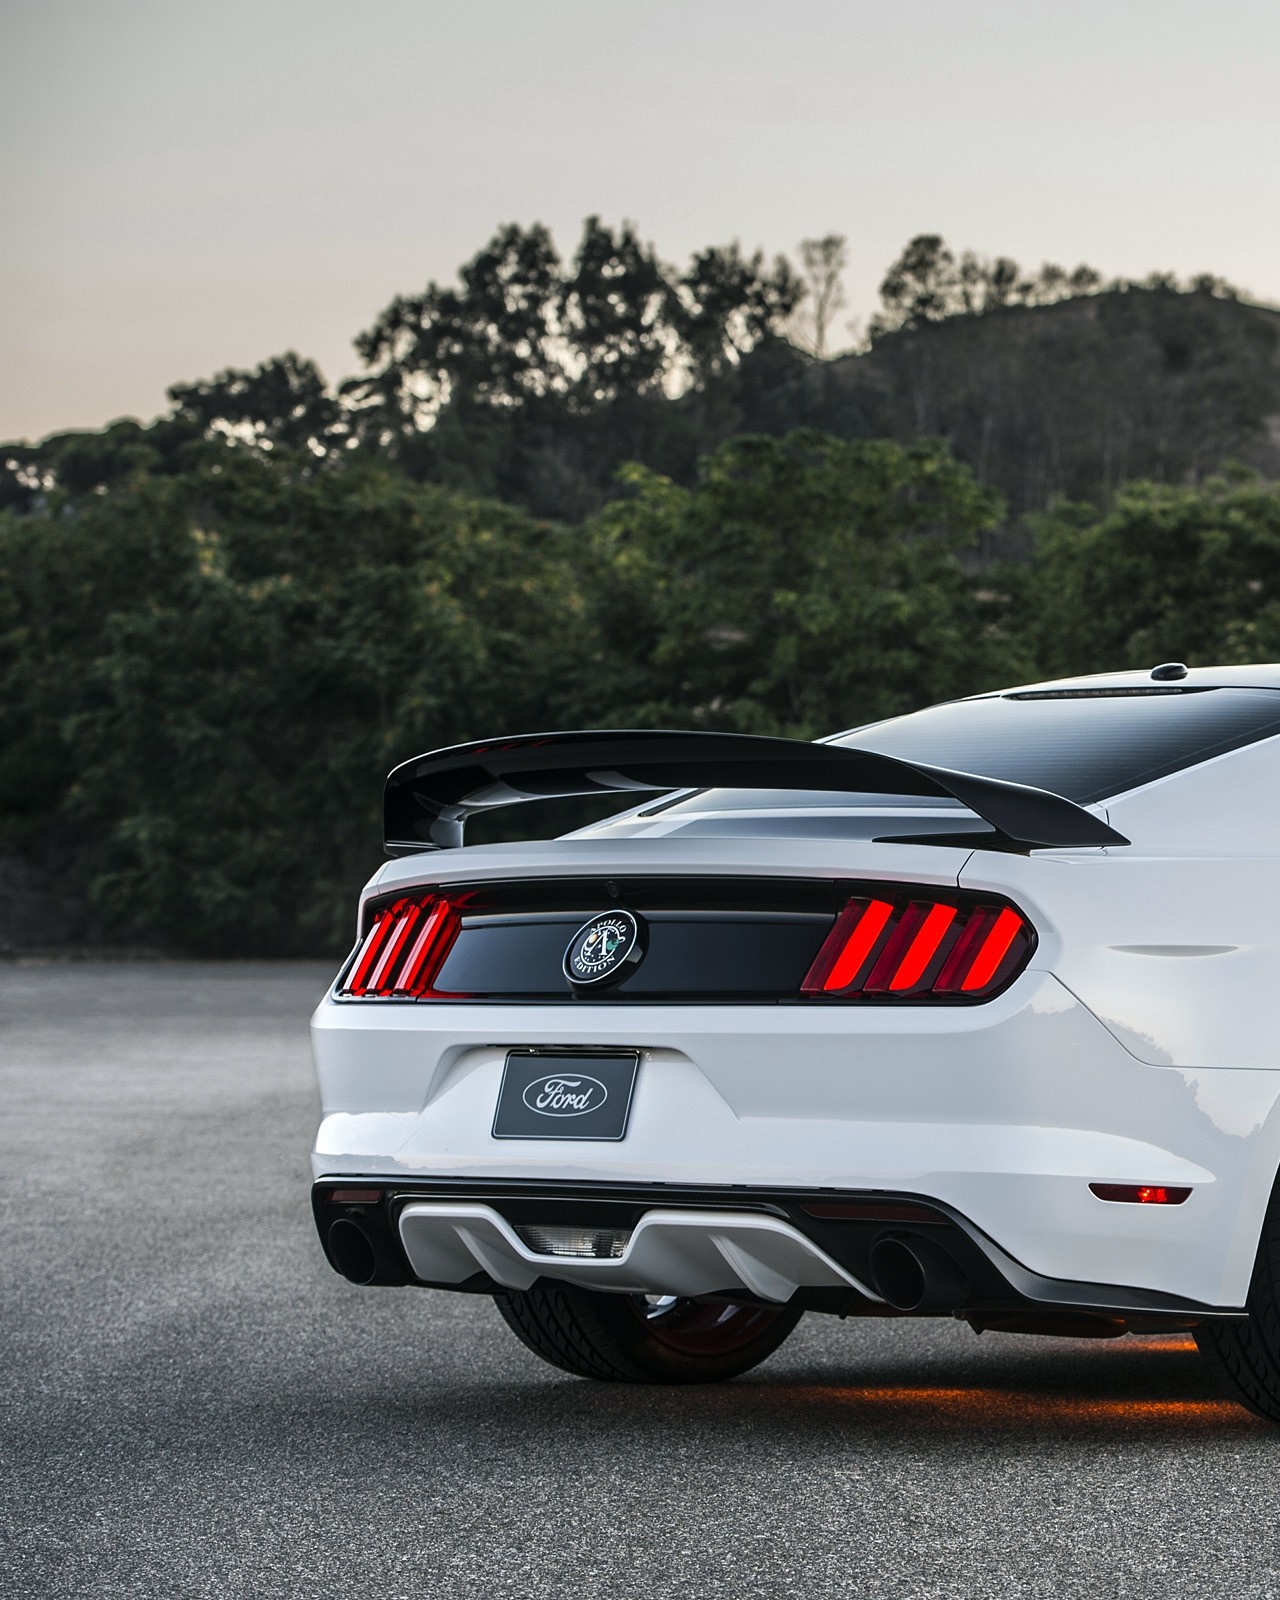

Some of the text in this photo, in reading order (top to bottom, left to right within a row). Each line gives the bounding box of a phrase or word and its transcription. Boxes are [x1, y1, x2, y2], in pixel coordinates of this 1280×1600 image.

[589, 918, 627, 934] APOLLO
[573, 955, 616, 974] EDITION
[536, 1078, 594, 1110] Ford
